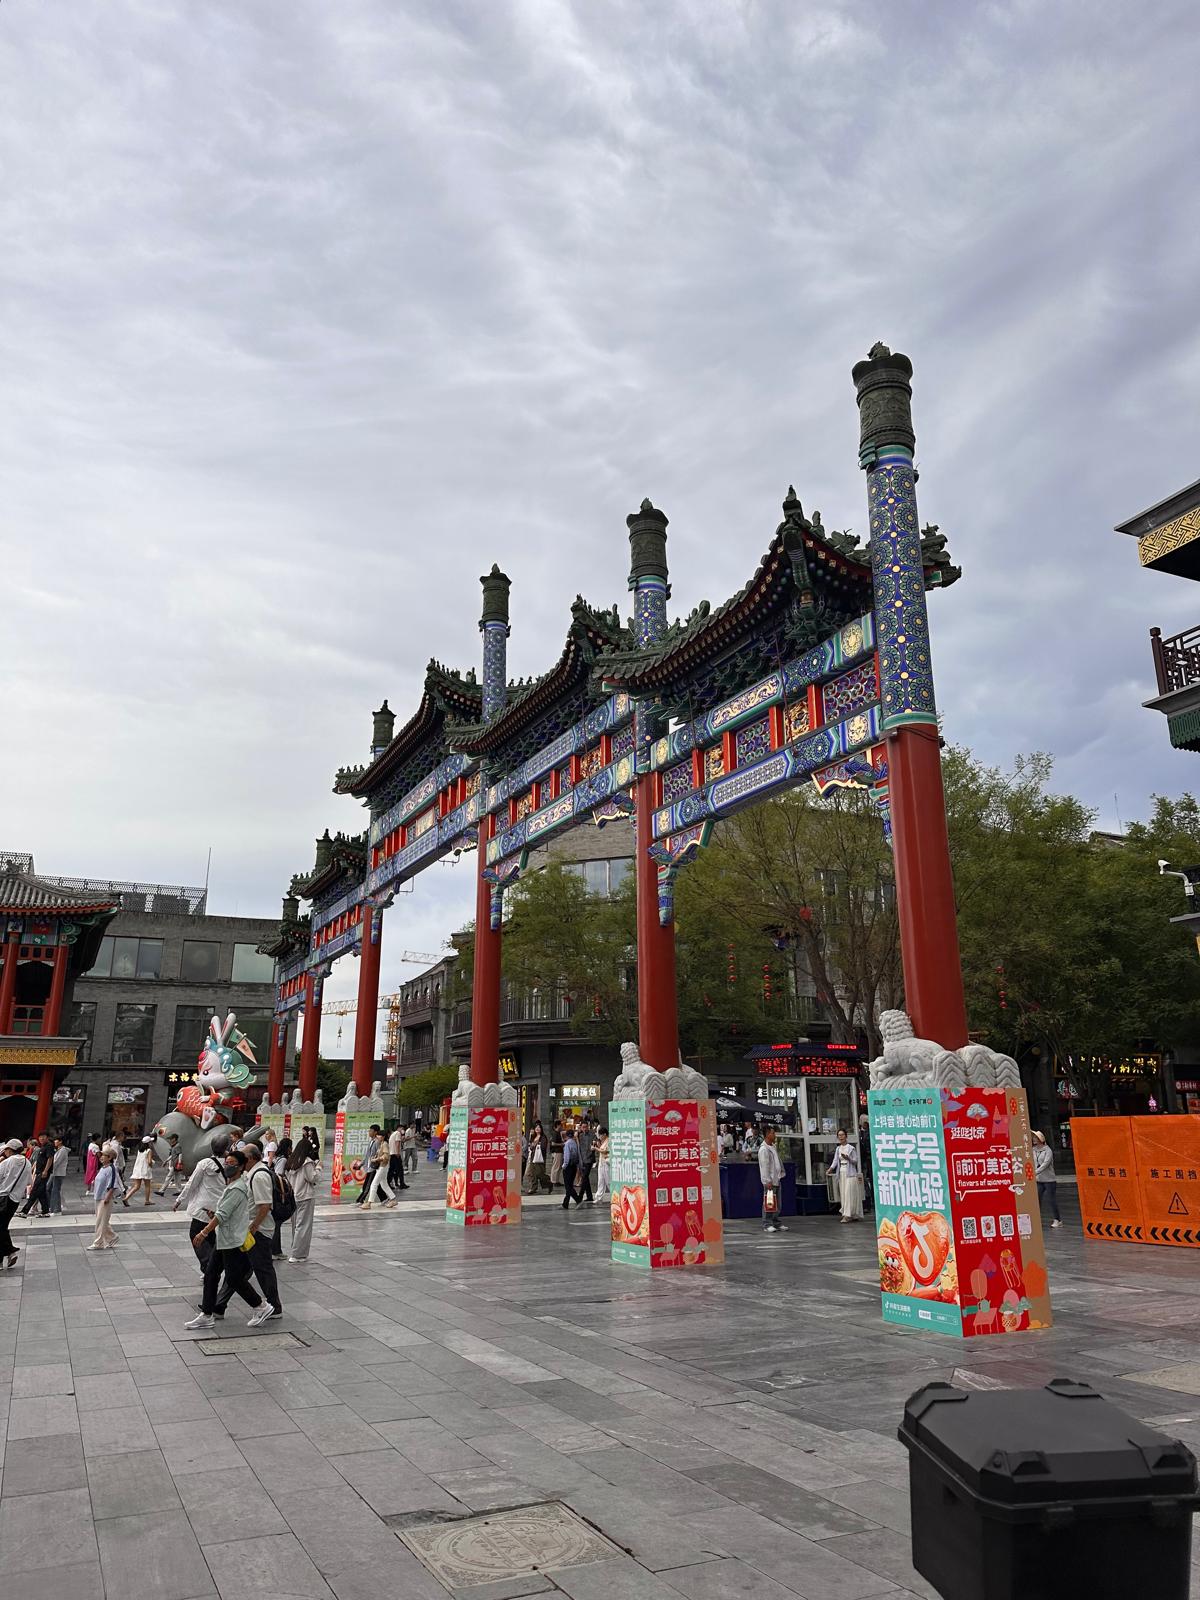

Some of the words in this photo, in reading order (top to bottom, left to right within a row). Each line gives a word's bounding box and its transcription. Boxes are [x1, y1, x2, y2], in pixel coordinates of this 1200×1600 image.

[873, 1115, 895, 1128] 上抖音
[611, 1131, 644, 1157] 老字号
[875, 1132, 941, 1170] 老字号
[1087, 1167, 1127, 1178] 施工围挡
[1150, 1168, 1198, 1180] 施工围挡
[877, 1170, 946, 1210] 新体验
